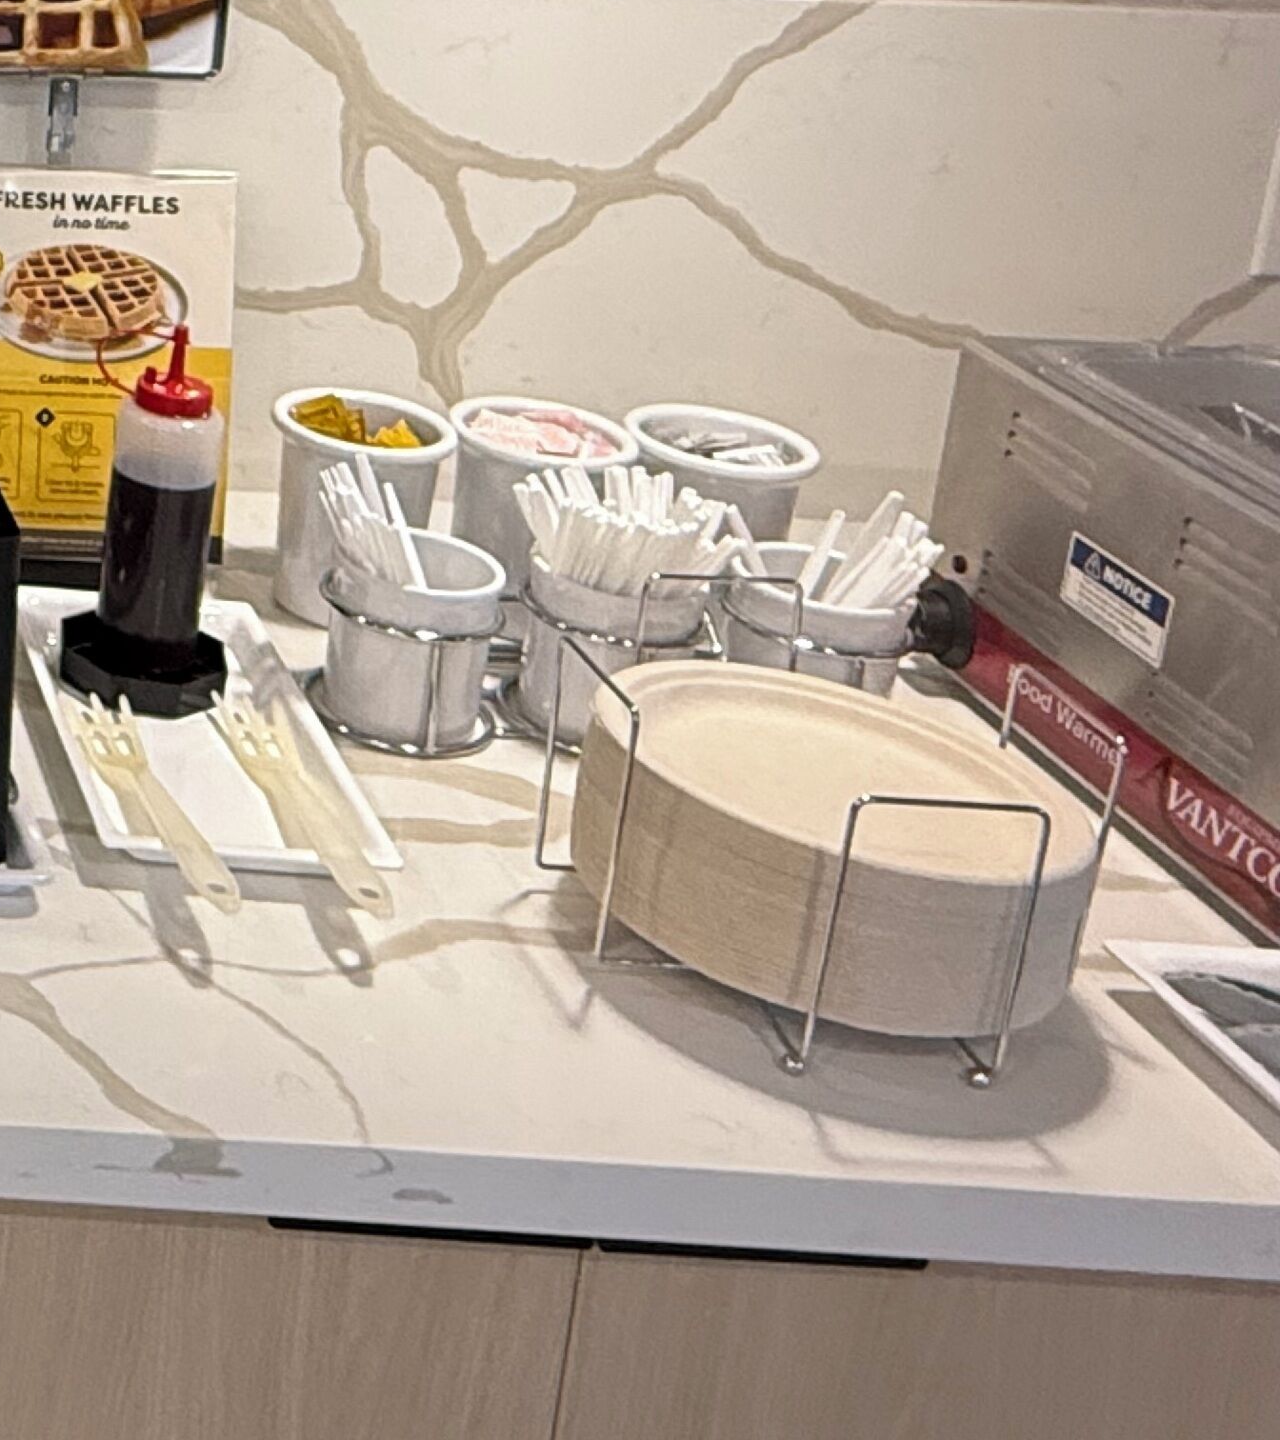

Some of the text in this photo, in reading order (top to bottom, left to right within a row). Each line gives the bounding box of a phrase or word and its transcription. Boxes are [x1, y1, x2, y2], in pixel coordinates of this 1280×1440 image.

[71, 192, 180, 215] WAFFLES
[52, 214, 131, 231] in no time
[40, 374, 90, 386] CAUTION
[1103, 565, 1152, 610] NOTICE
[1056, 699, 1121, 766] Warme
